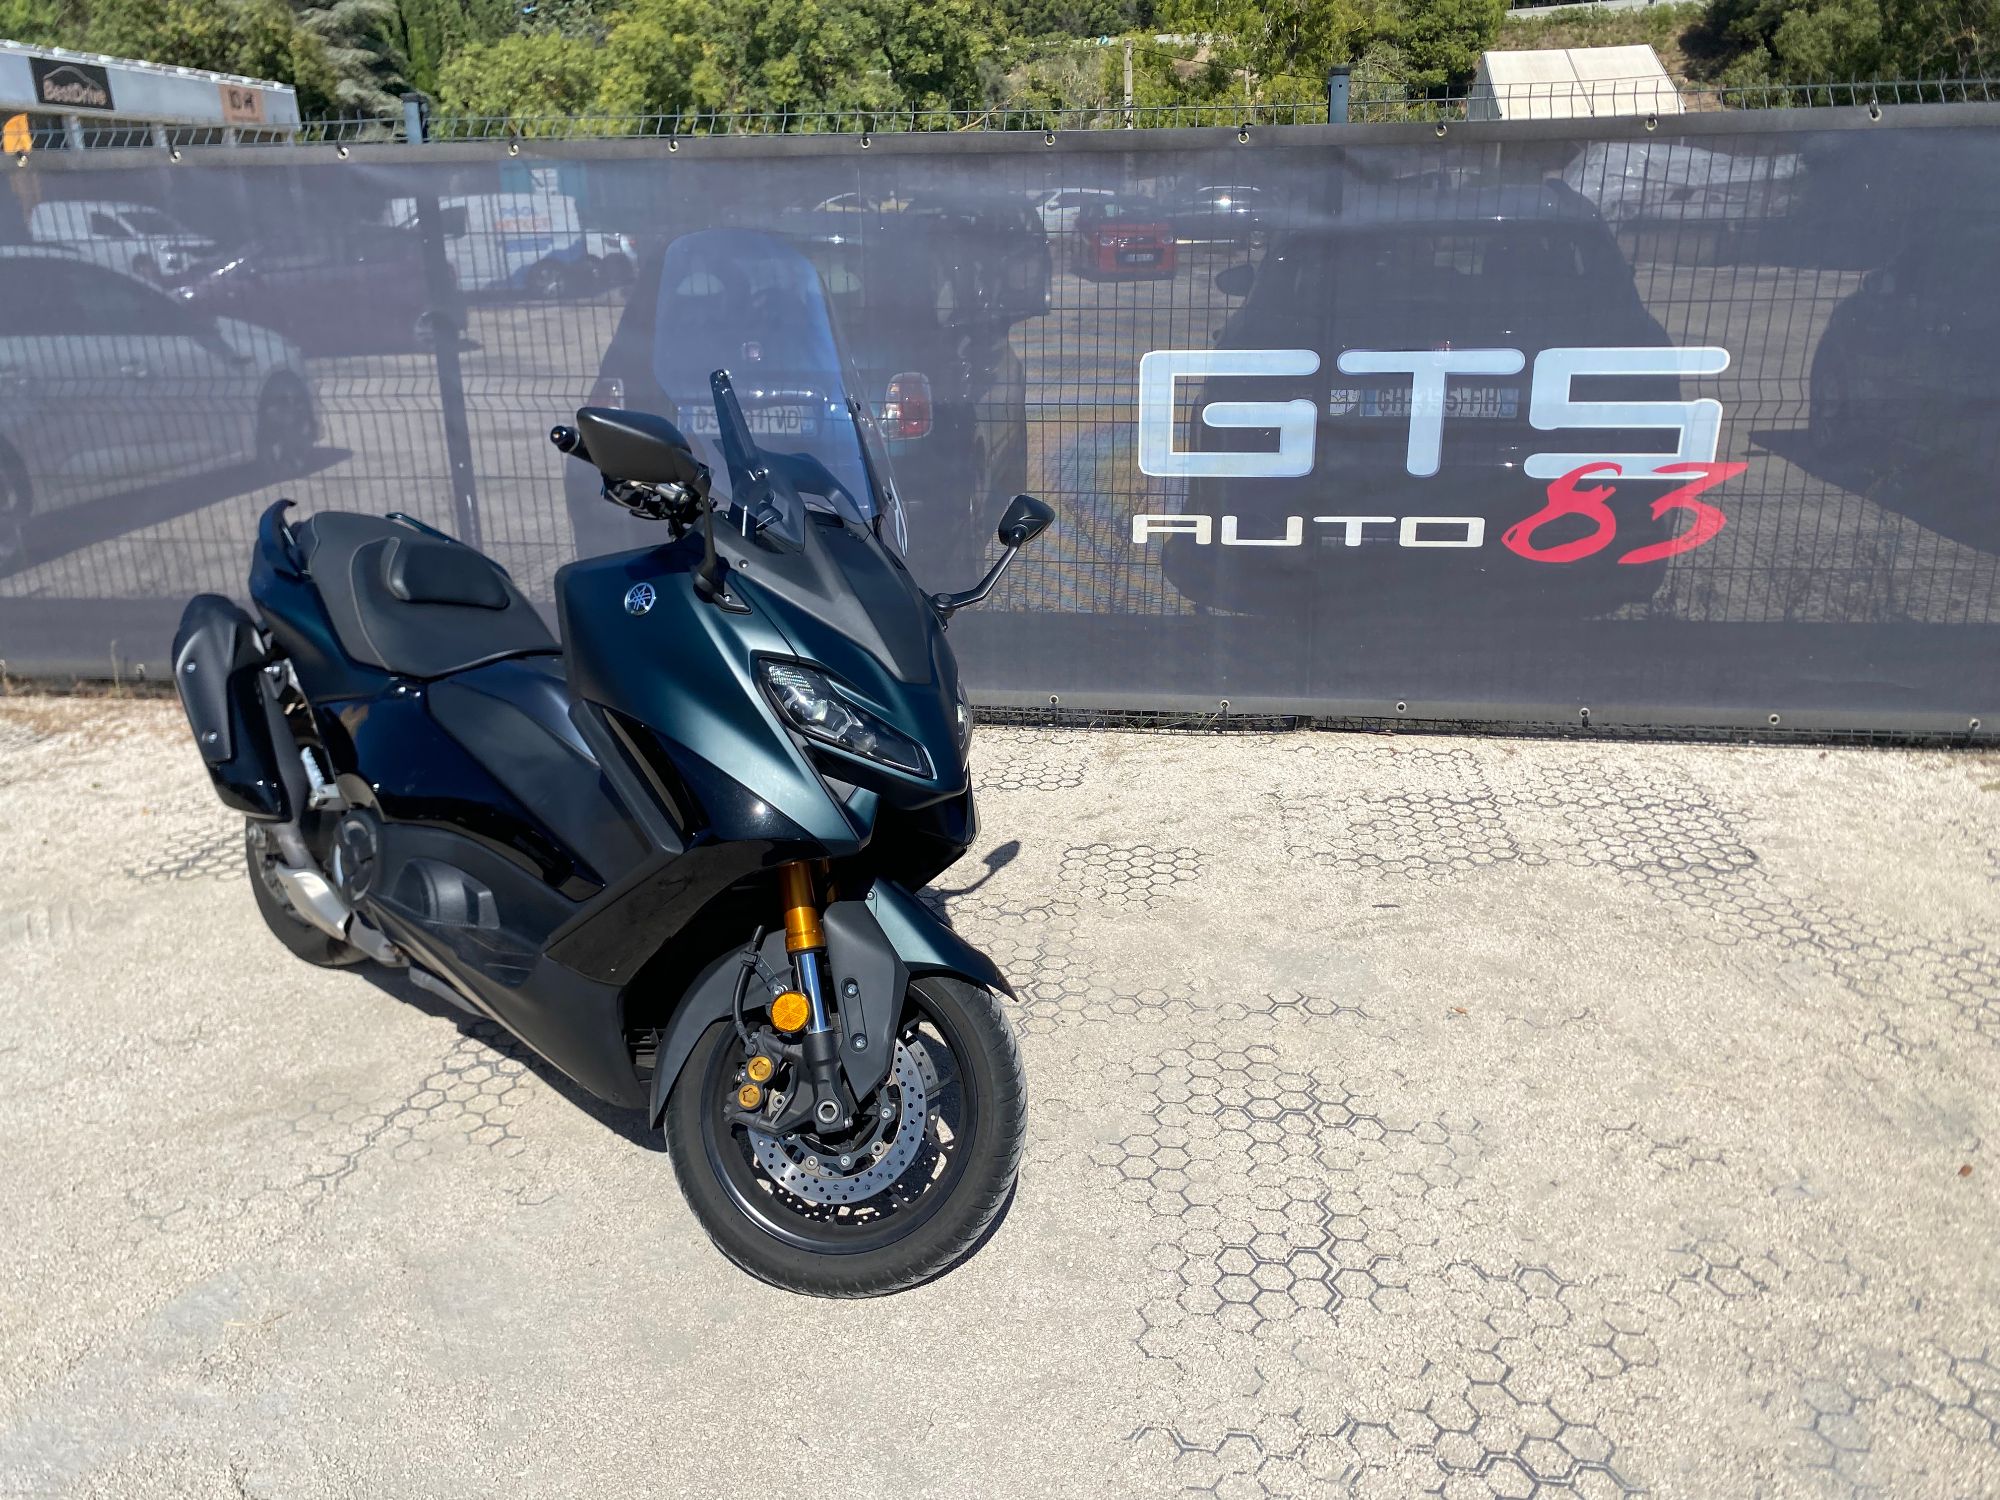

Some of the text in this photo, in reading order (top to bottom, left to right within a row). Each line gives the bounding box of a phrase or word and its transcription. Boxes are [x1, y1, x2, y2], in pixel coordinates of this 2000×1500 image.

[1139, 346, 1731, 479] GTS
[1132, 461, 1749, 564] AUTO 83
